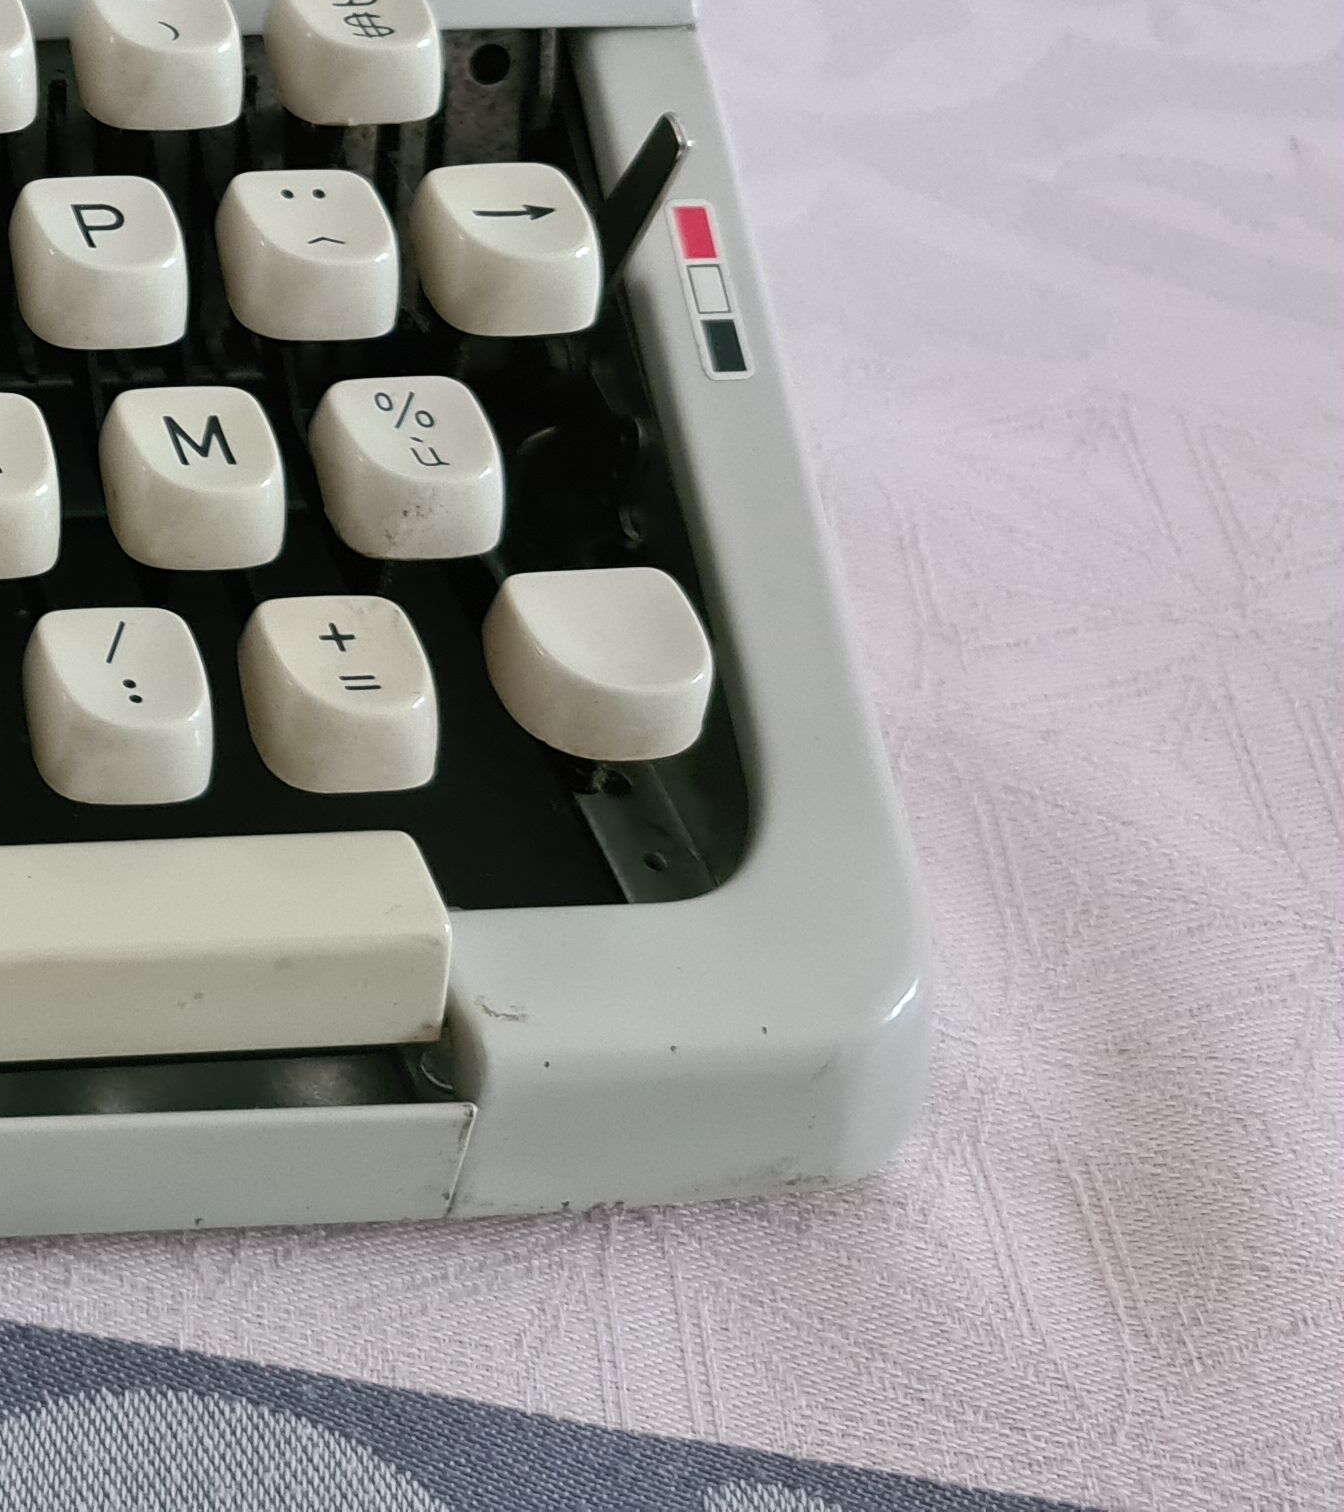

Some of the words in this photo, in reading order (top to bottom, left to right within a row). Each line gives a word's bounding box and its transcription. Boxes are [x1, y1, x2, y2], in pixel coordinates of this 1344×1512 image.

[70, 203, 126, 249] P
[373, 391, 437, 430] %
[162, 414, 238, 466] M
